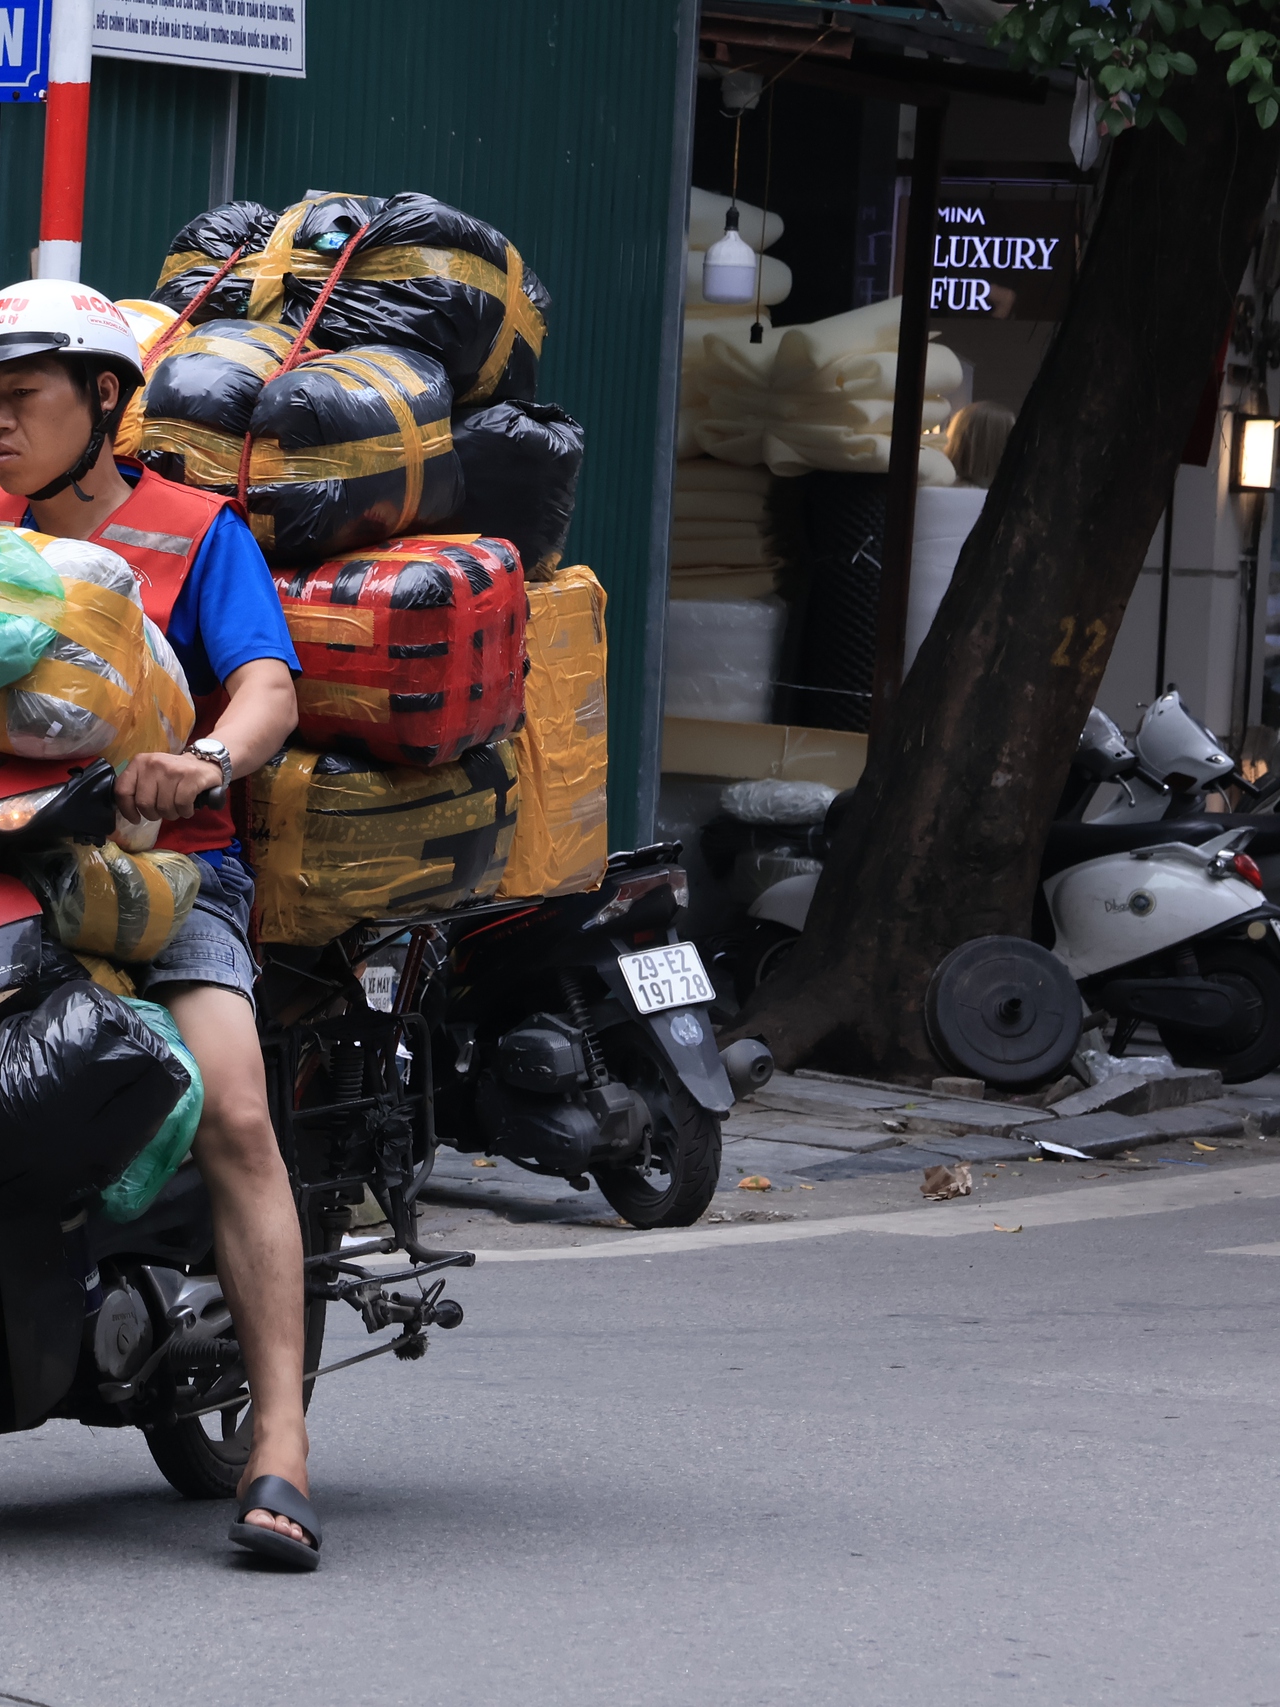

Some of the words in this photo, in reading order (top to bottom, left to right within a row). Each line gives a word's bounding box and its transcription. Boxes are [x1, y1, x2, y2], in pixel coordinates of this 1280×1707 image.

[933, 235, 1060, 270] LUXURY
[930, 276, 992, 311] FUR
[631, 948, 692, 981] 29-E2
[637, 973, 707, 1008] 197.28
